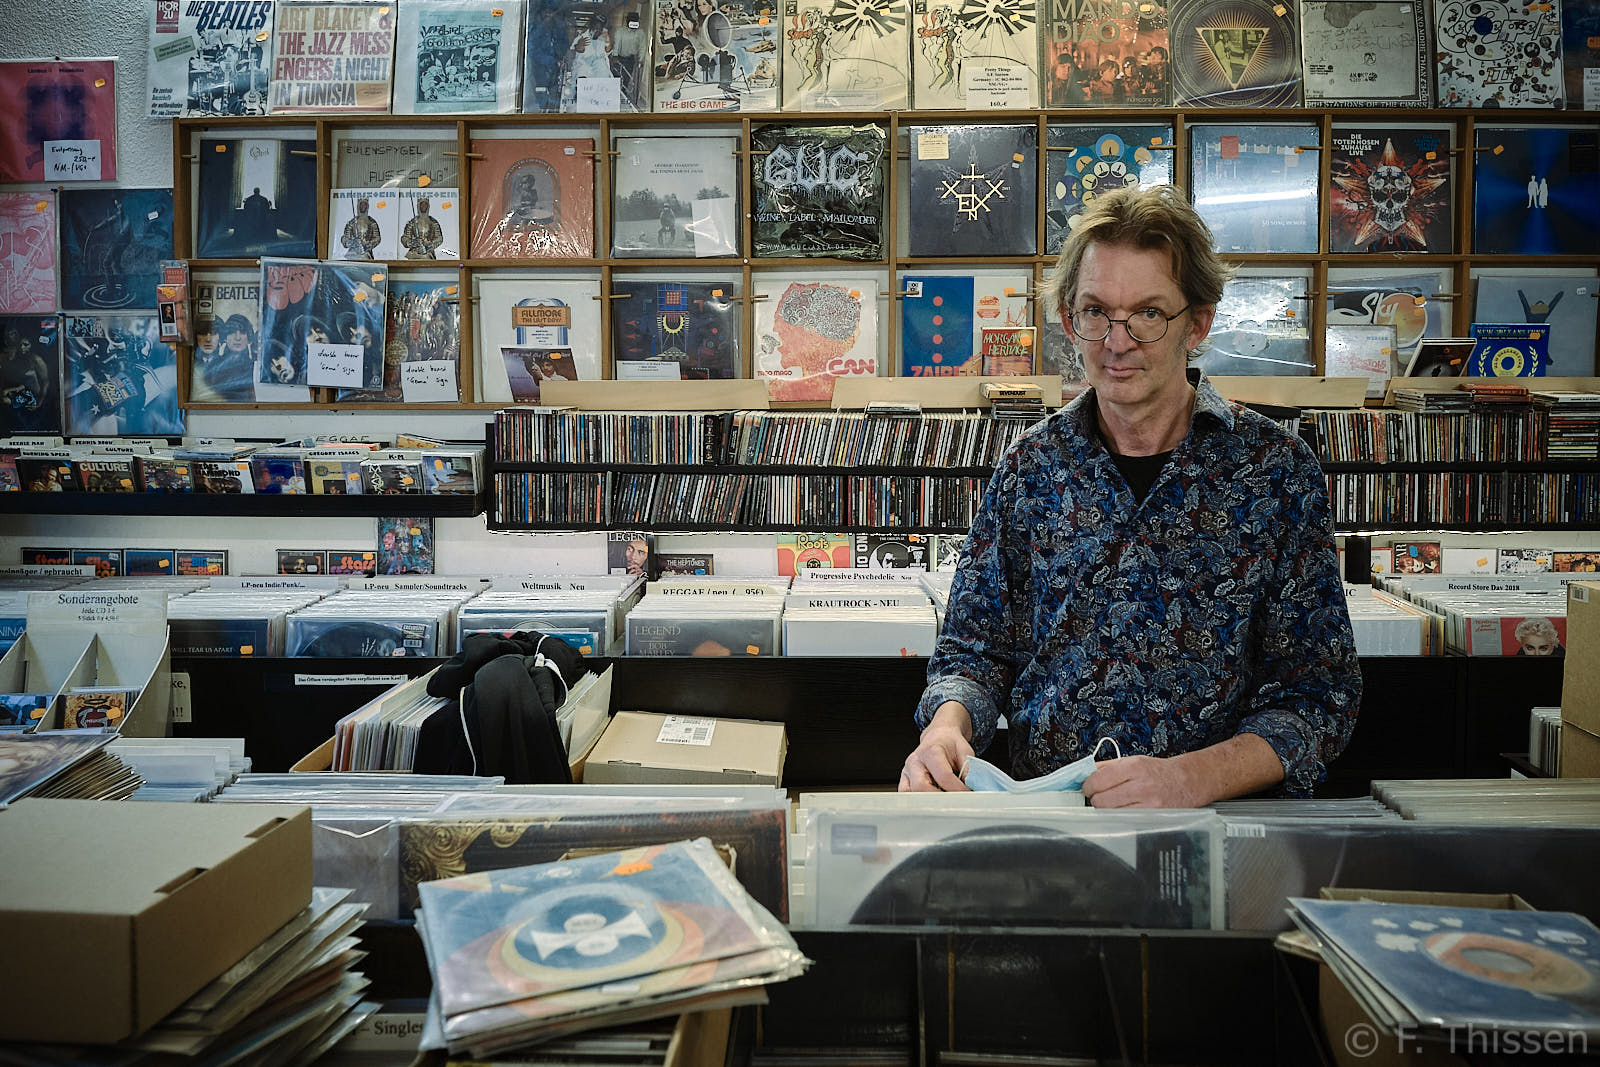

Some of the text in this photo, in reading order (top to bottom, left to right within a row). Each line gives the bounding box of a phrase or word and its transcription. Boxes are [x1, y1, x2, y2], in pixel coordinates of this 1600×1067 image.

[163, 11, 174, 20] ZU
[186, 1, 272, 30] DIE BEATLES
[1053, 0, 1158, 20] MANDO
[278, 8, 307, 31] ART
[313, 8, 374, 31] BLAKEY
[1053, 21, 1120, 43] DIAO
[278, 32, 392, 55] THE JAZZ MESS
[275, 58, 389, 81] ENGERS A NIGHT
[272, 82, 357, 106] IN TUNISIA
[660, 101, 727, 109] THE BIG GAME
[216, 286, 260, 300] BEATLES
[521, 309, 562, 318] FILLMORE
[983, 332, 1021, 344] MORGAN
[988, 343, 1029, 357] HERITAGE
[828, 358, 875, 376] CAN
[315, 435, 370, 443] EGGAE
[79, 462, 129, 472] CULTURE
[607, 532, 647, 542] LEGEN
[797, 533, 829, 550] Roots
[341, 556, 375, 570] Stars
[44, 567, 82, 576] gebraucht
[810, 572, 852, 581] Progressive
[853, 572, 895, 581] Psychedelic
[521, 581, 585, 591] Weltmusik Neu
[1448, 583, 1471, 591] Record
[1472, 583, 1490, 591] Store
[1490, 584, 1503, 592] Day
[58, 593, 139, 606] Sonderangebote
[808, 599, 872, 608] KRAUTROCK
[879, 599, 900, 608] NEU
[634, 625, 681, 636] LEGEND
[374, 1021, 425, 1037] Singles
